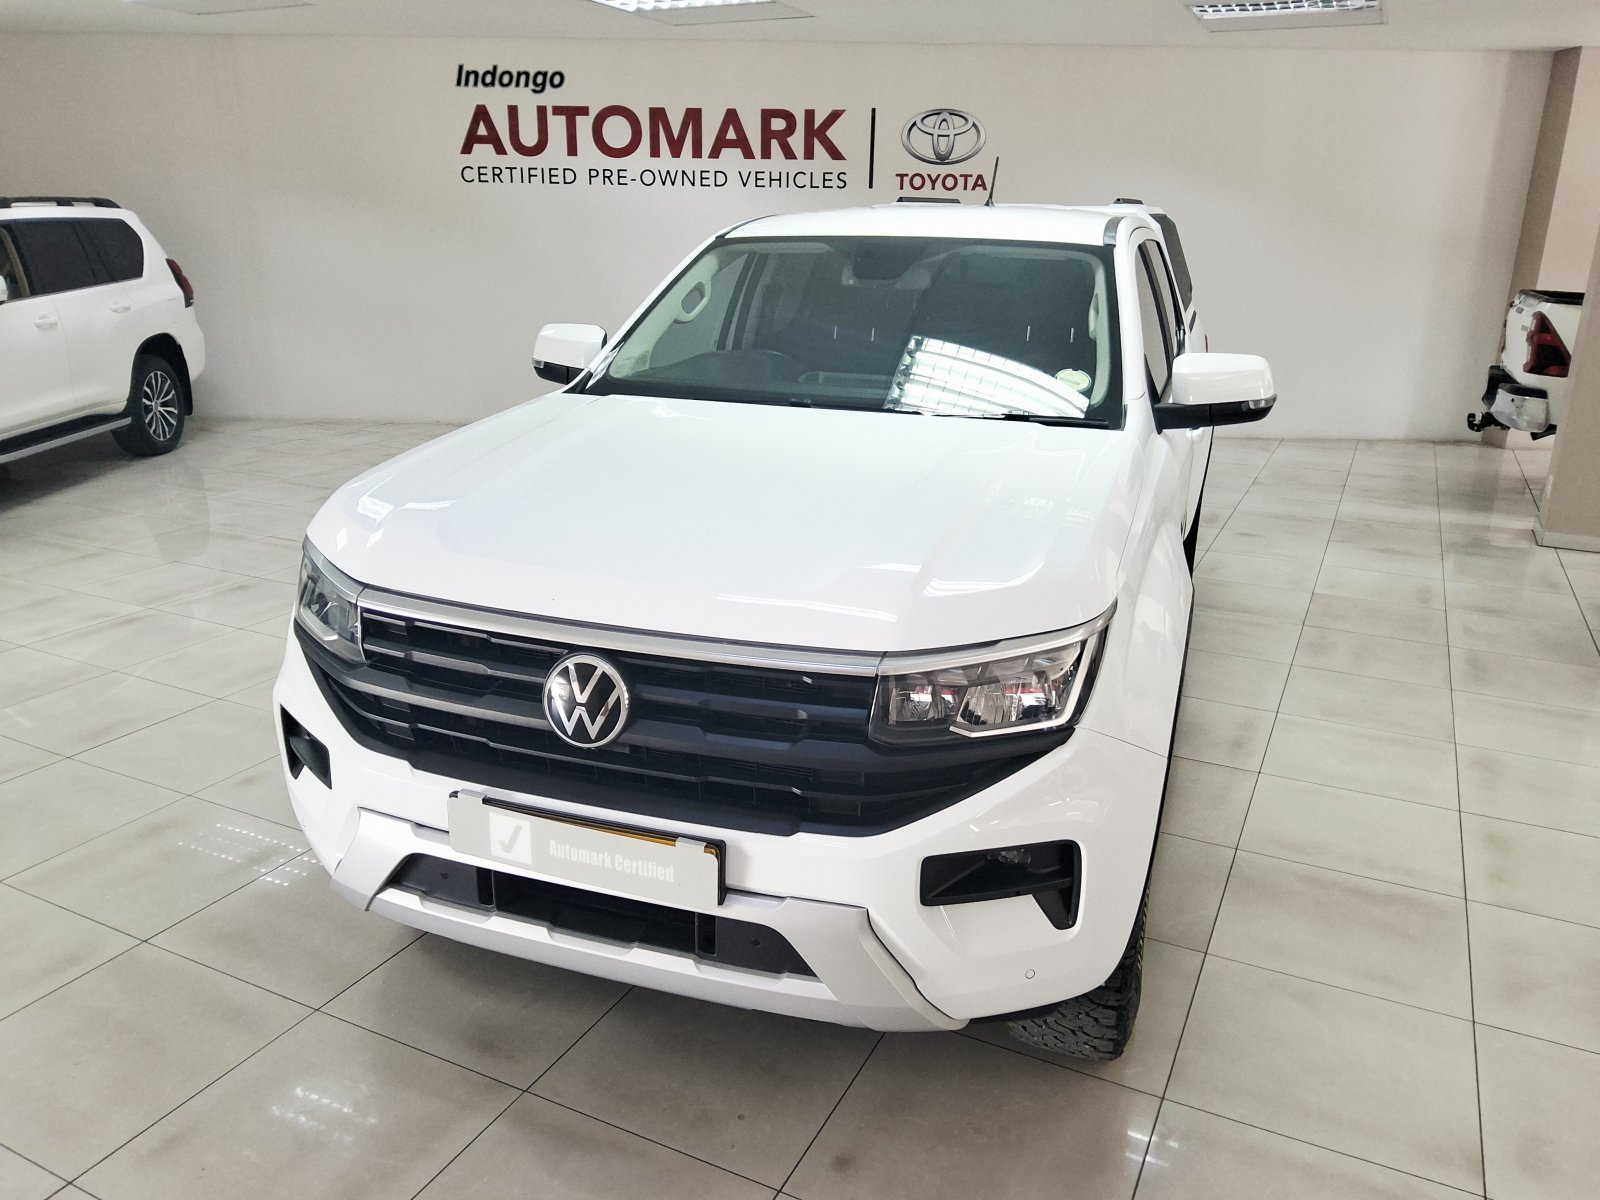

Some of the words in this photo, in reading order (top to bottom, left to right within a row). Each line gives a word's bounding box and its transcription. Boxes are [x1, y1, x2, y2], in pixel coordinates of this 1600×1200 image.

[455, 64, 565, 94] Indongo
[460, 104, 847, 161] AUTOMARK
[460, 166, 577, 185] CERTIFIED
[588, 168, 728, 188] PRE-OWNED
[737, 170, 848, 190] VEHICLES
[895, 172, 988, 191] TOYOTA
[549, 839, 612, 869] Automark
[614, 854, 674, 882] Certified
